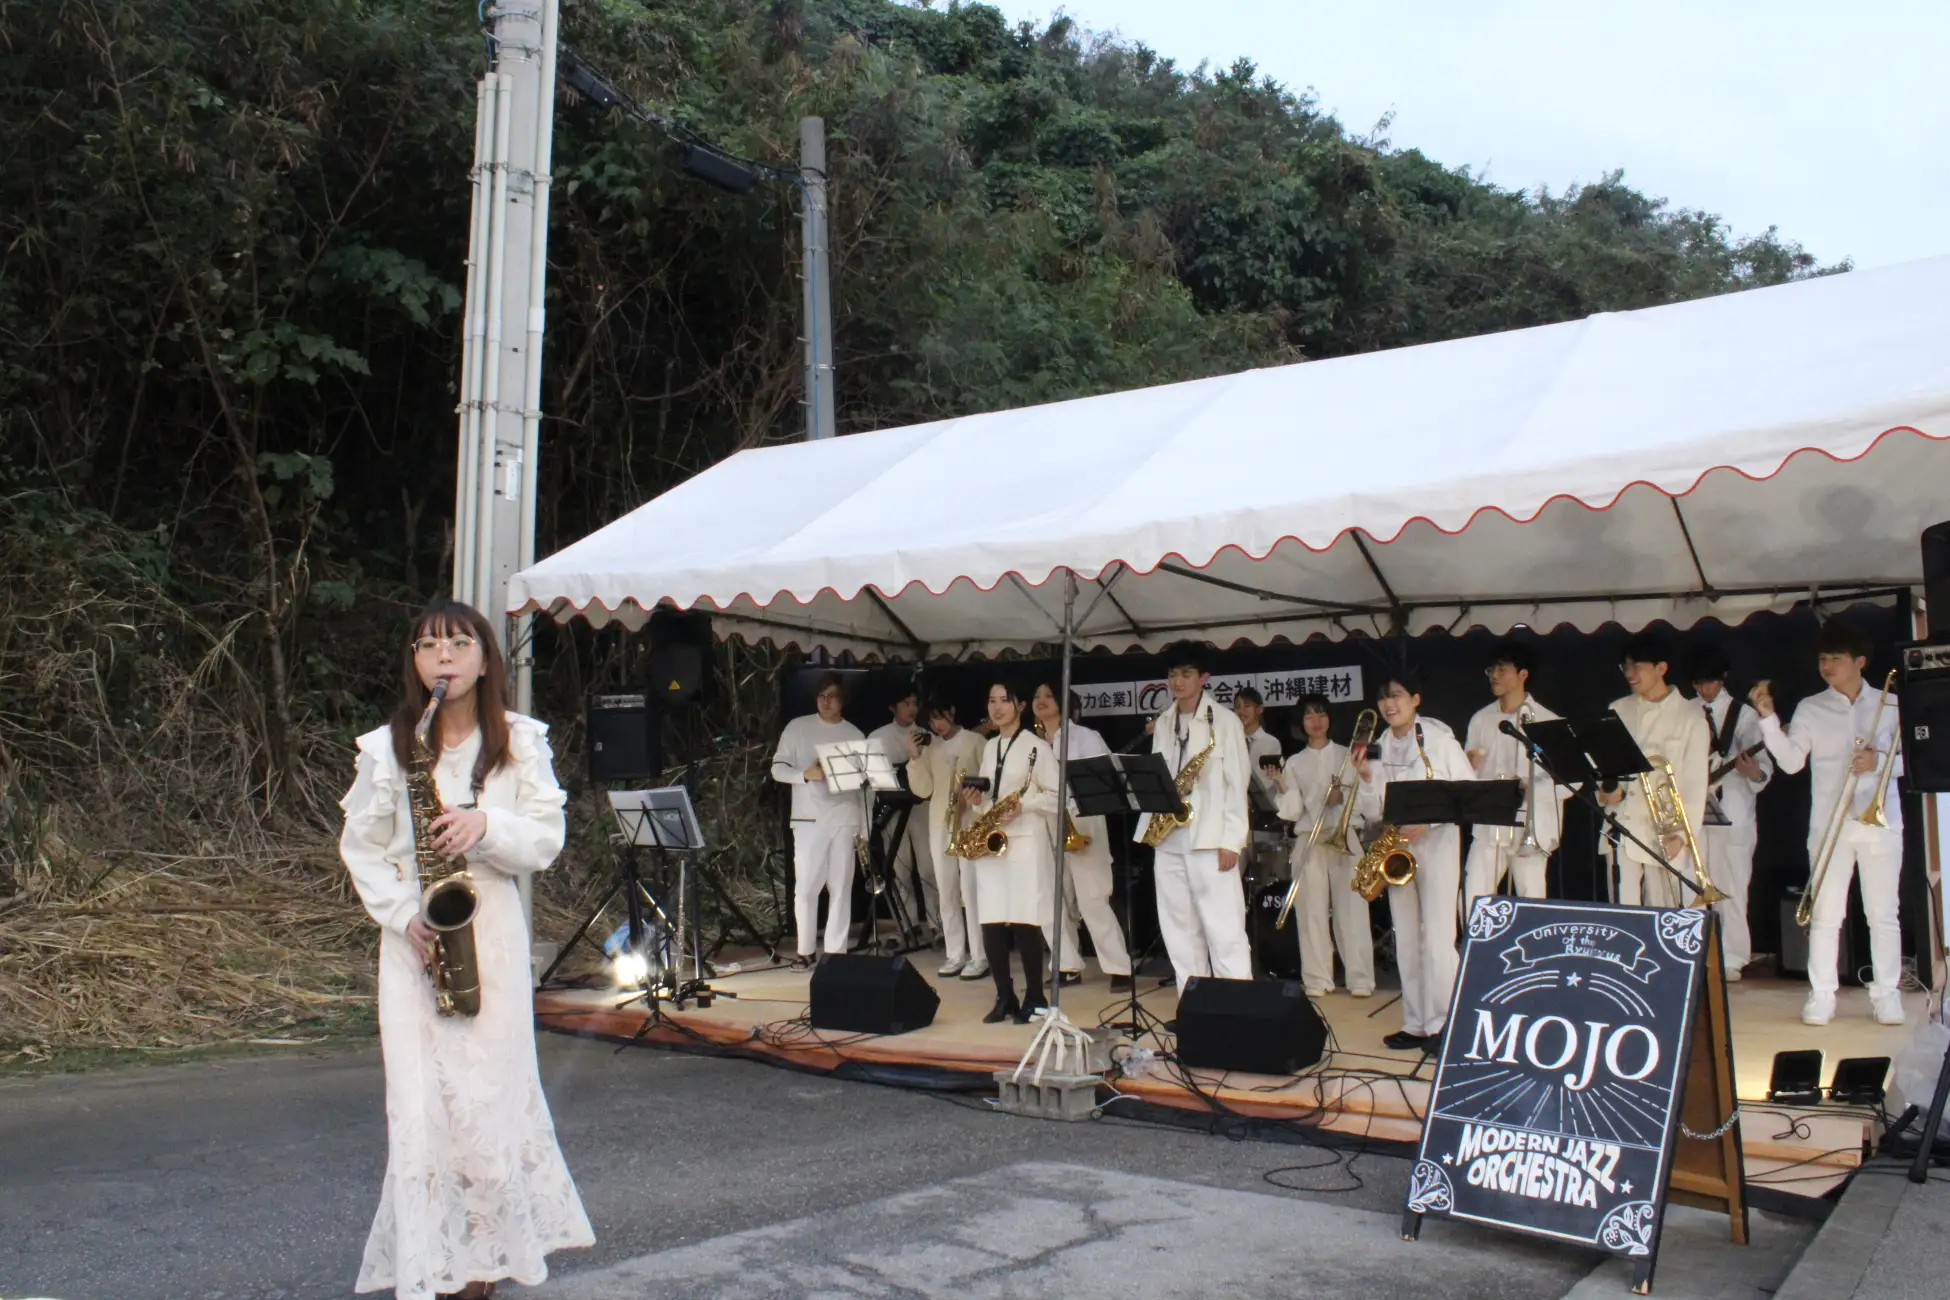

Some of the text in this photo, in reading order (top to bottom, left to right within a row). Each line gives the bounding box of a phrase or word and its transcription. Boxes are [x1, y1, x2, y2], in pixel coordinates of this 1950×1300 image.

[1080, 690, 1132, 709] 力企業】
[1532, 925, 1619, 941] University
[1562, 934, 1596, 946] of the
[1464, 1009, 1659, 1090] MOJO
[1456, 1124, 1621, 1194] MODERN JAZZ
[1467, 1151, 1597, 1209] ORCHESTRA
